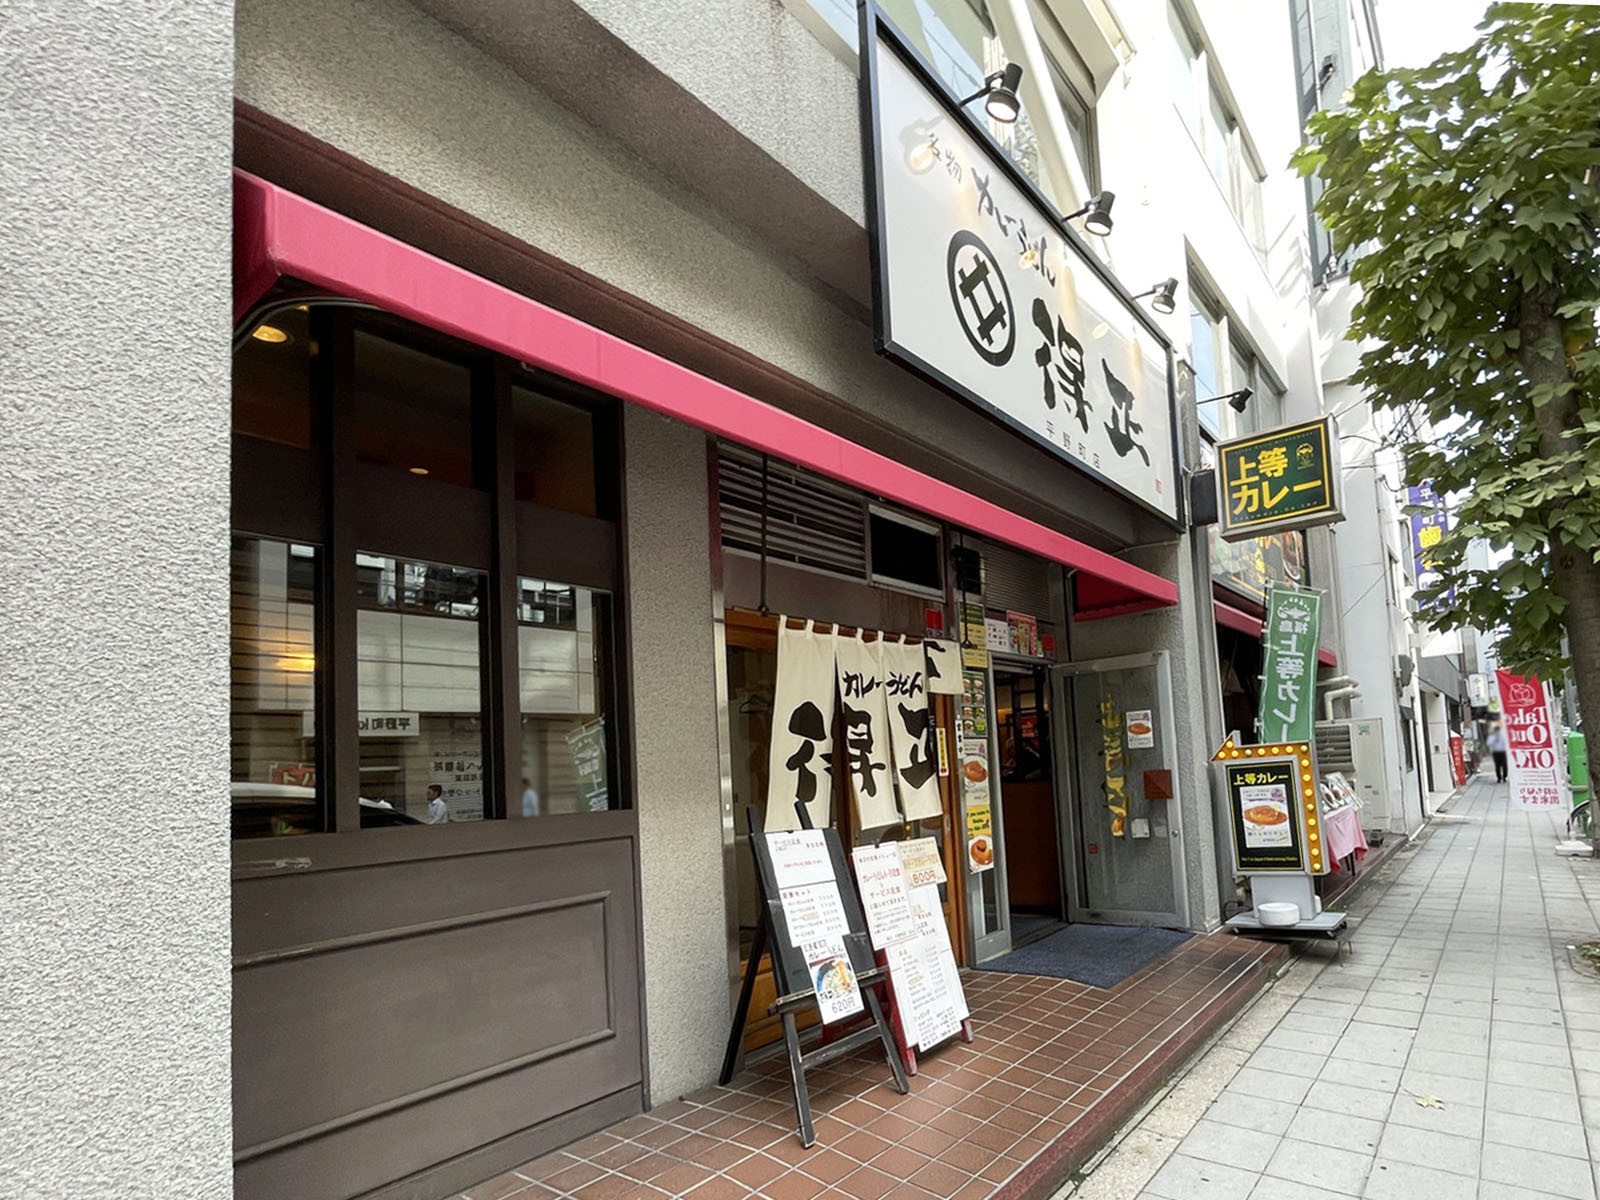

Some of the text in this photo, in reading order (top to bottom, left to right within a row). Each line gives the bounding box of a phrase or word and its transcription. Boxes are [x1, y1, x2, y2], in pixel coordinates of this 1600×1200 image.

[1032, 297, 1150, 467] 得正
[1230, 447, 1288, 486] 上等
[1232, 479, 1322, 515] カレー
[843, 671, 924, 698] カレーうどん
[1233, 772, 1288, 785] 上等カレー
[912, 870, 936, 885] 800円
[832, 995, 856, 1014] 620円
